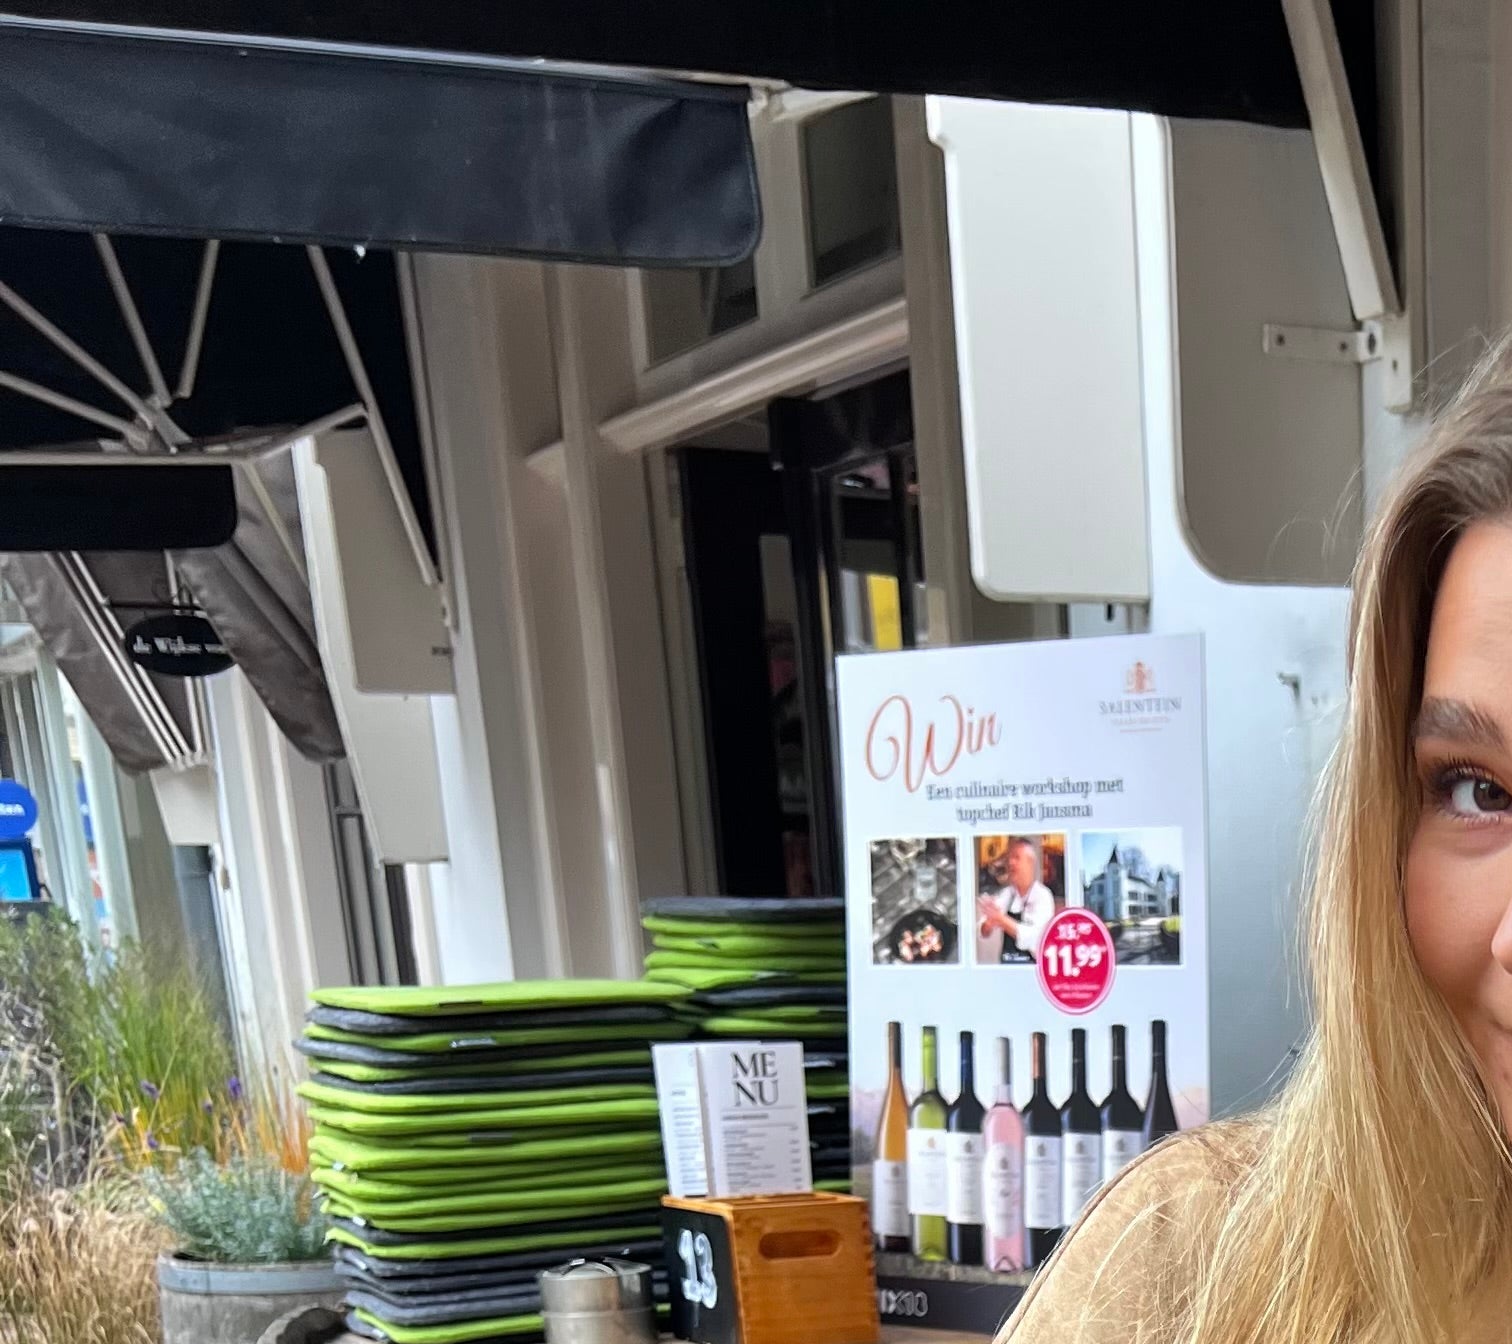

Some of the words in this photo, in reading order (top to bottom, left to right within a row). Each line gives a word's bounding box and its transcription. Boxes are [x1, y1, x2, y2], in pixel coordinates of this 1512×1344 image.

[865, 694, 1002, 793] Win
[926, 783, 953, 801] Een
[955, 780, 1018, 799] culinaire
[1020, 777, 1092, 799] workshop
[1095, 777, 1124, 793] met
[956, 803, 1009, 827] topchef
[730, 1050, 778, 1079] ME
[732, 1079, 780, 1107] NU
